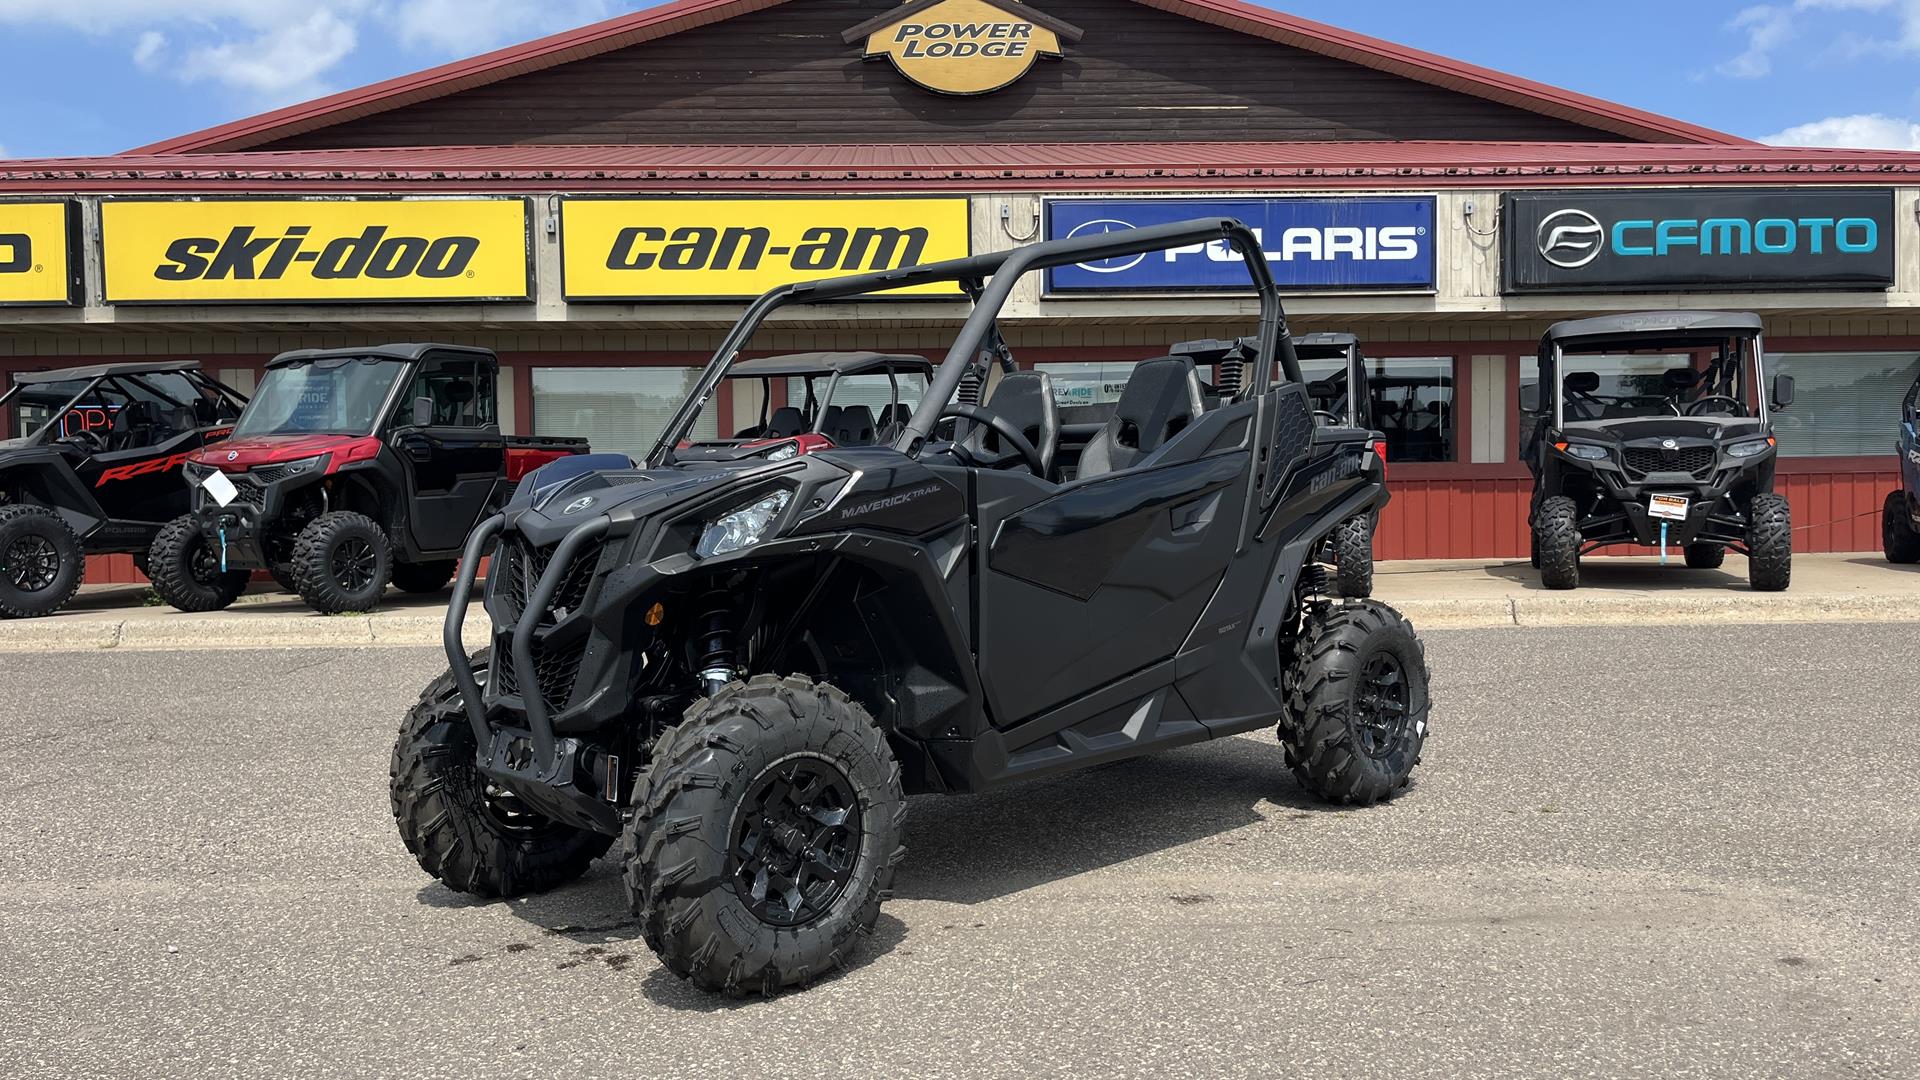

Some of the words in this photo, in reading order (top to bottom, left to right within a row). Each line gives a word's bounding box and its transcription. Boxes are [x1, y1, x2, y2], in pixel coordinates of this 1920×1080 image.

[894, 23, 1033, 42] POWER
[902, 41, 1028, 58] LODGE
[154, 225, 480, 280] ski-doo
[605, 227, 929, 271] can-am
[1611, 218, 1878, 256] CFMOTO
[842, 493, 912, 519] MAVERICK
[912, 485, 941, 498] TRAIL
